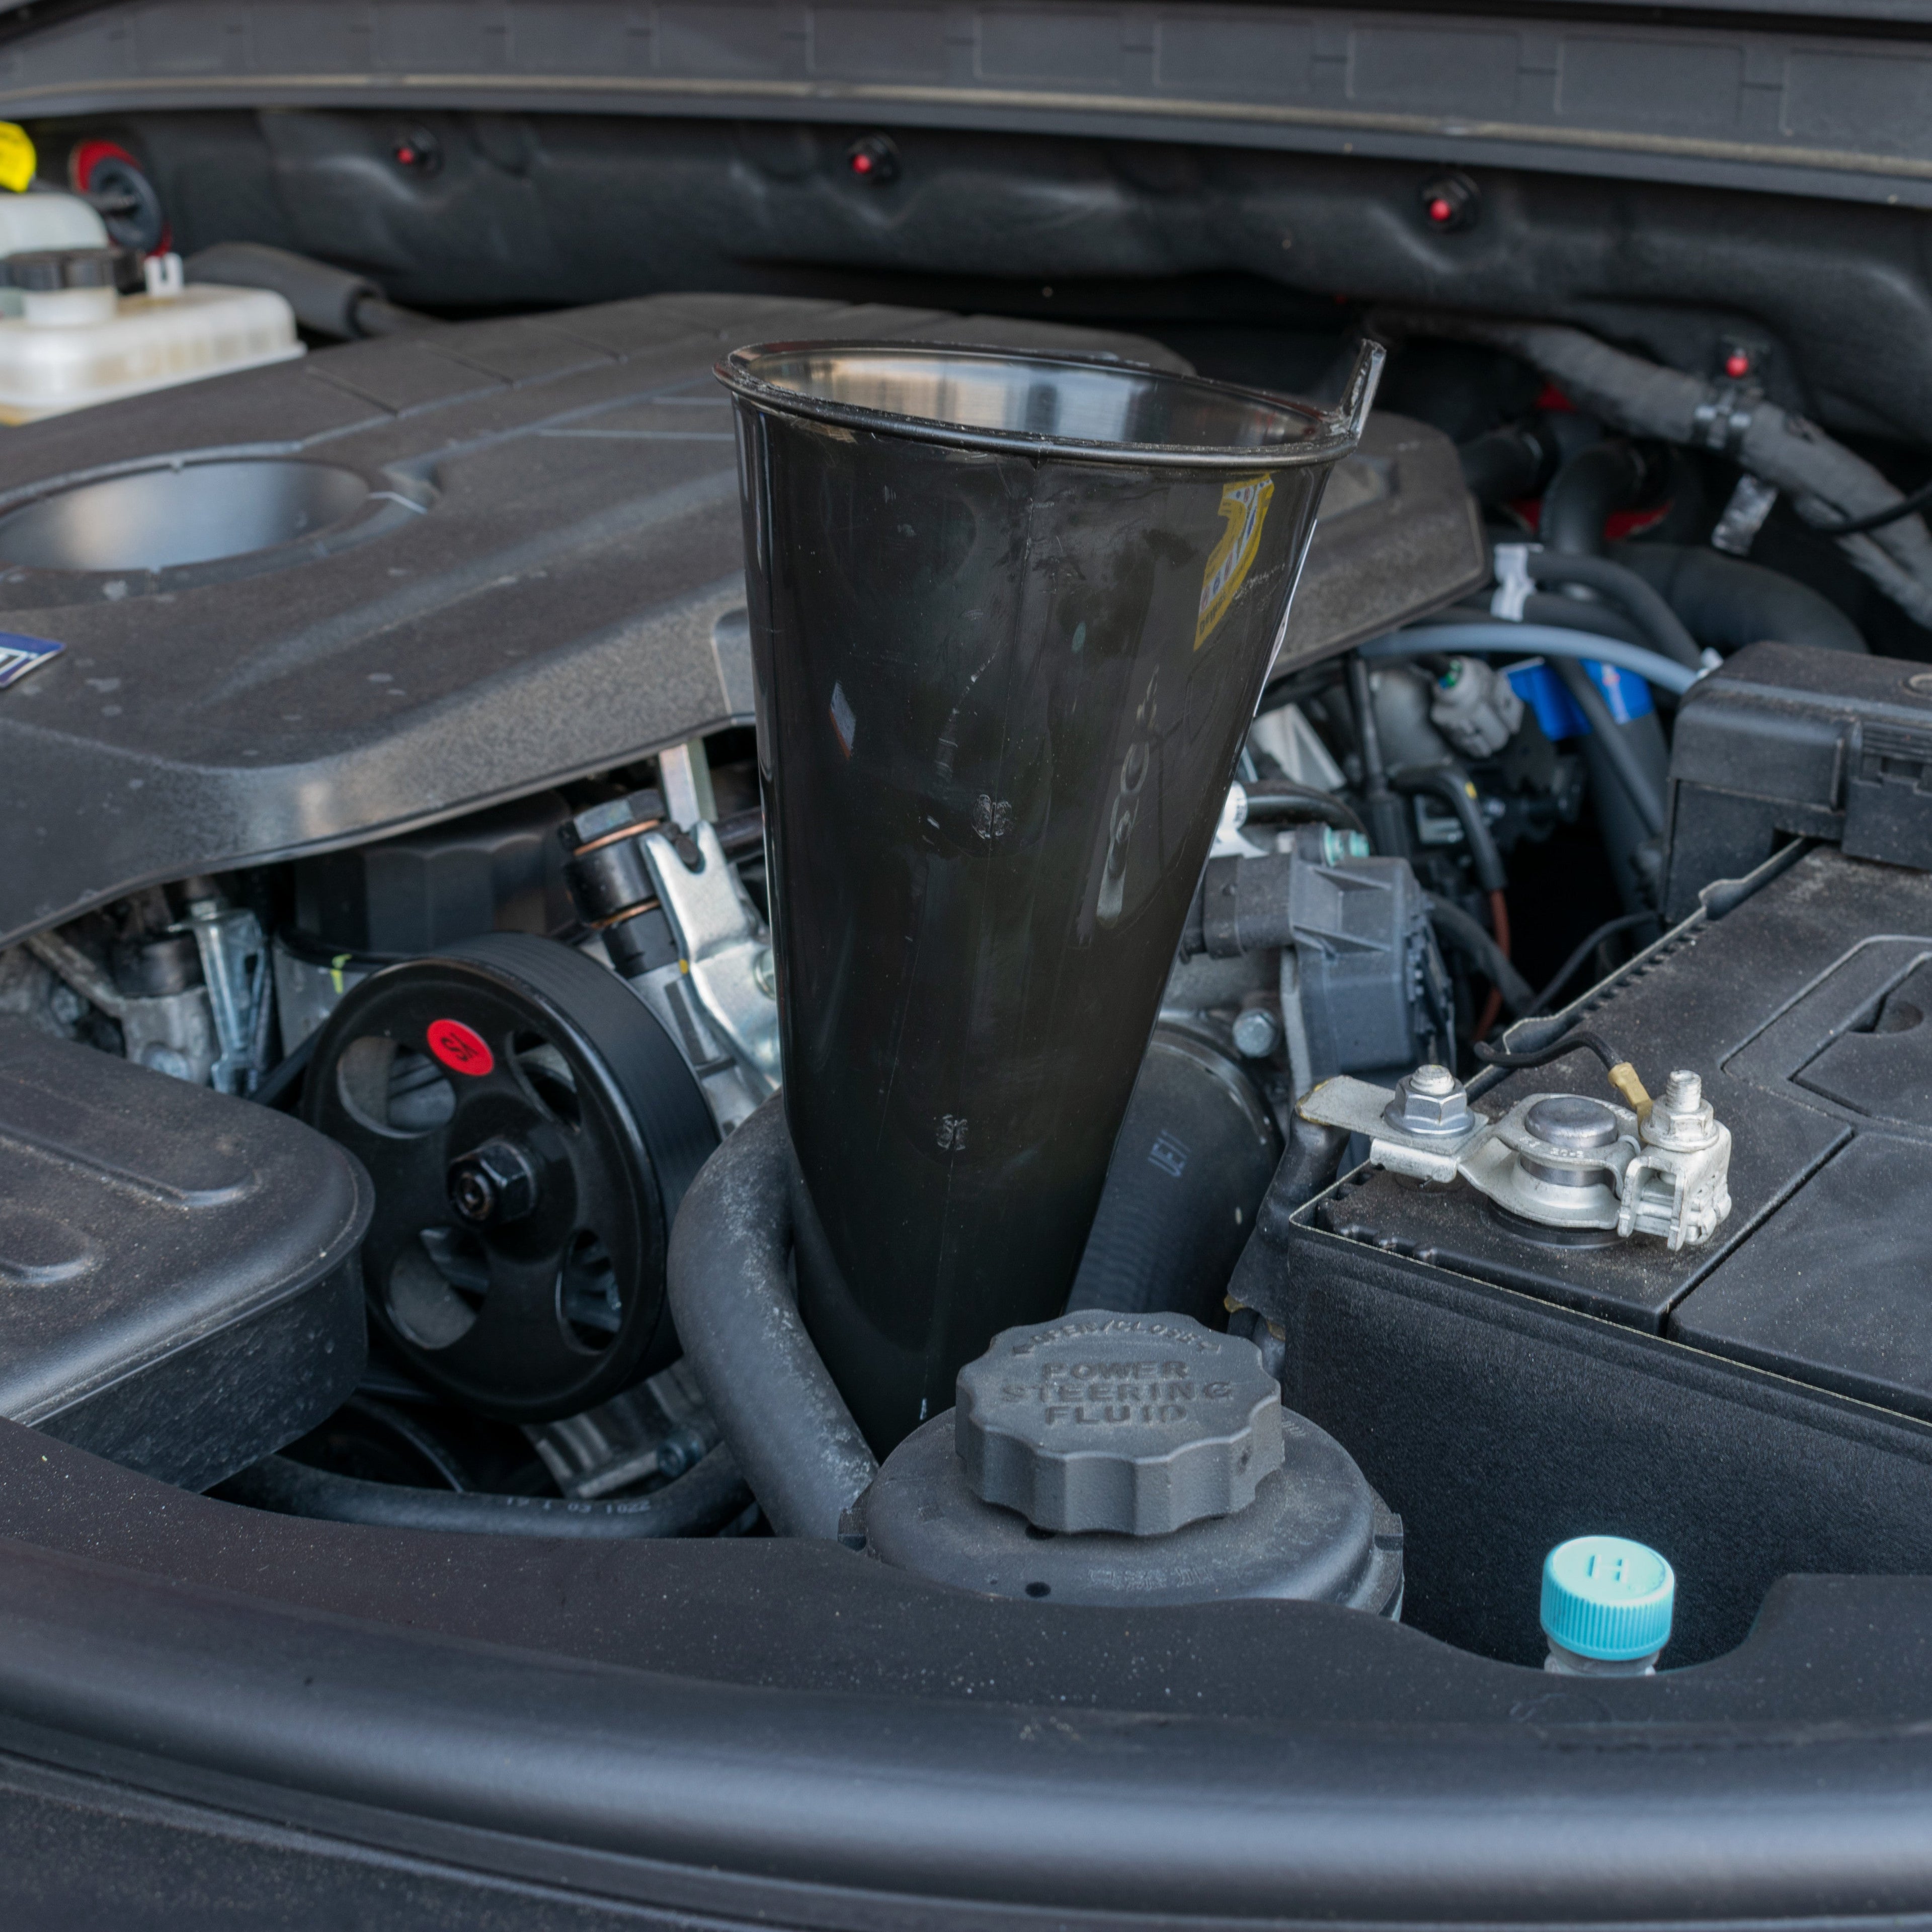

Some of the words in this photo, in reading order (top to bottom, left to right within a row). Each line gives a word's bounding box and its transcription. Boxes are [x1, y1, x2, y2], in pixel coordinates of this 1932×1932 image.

[1041, 1360, 1189, 1381] POWER
[1001, 1380, 1234, 1403] STEERING
[1043, 1404, 1188, 1426] FLUID
[1586, 1554, 1630, 1585] H
